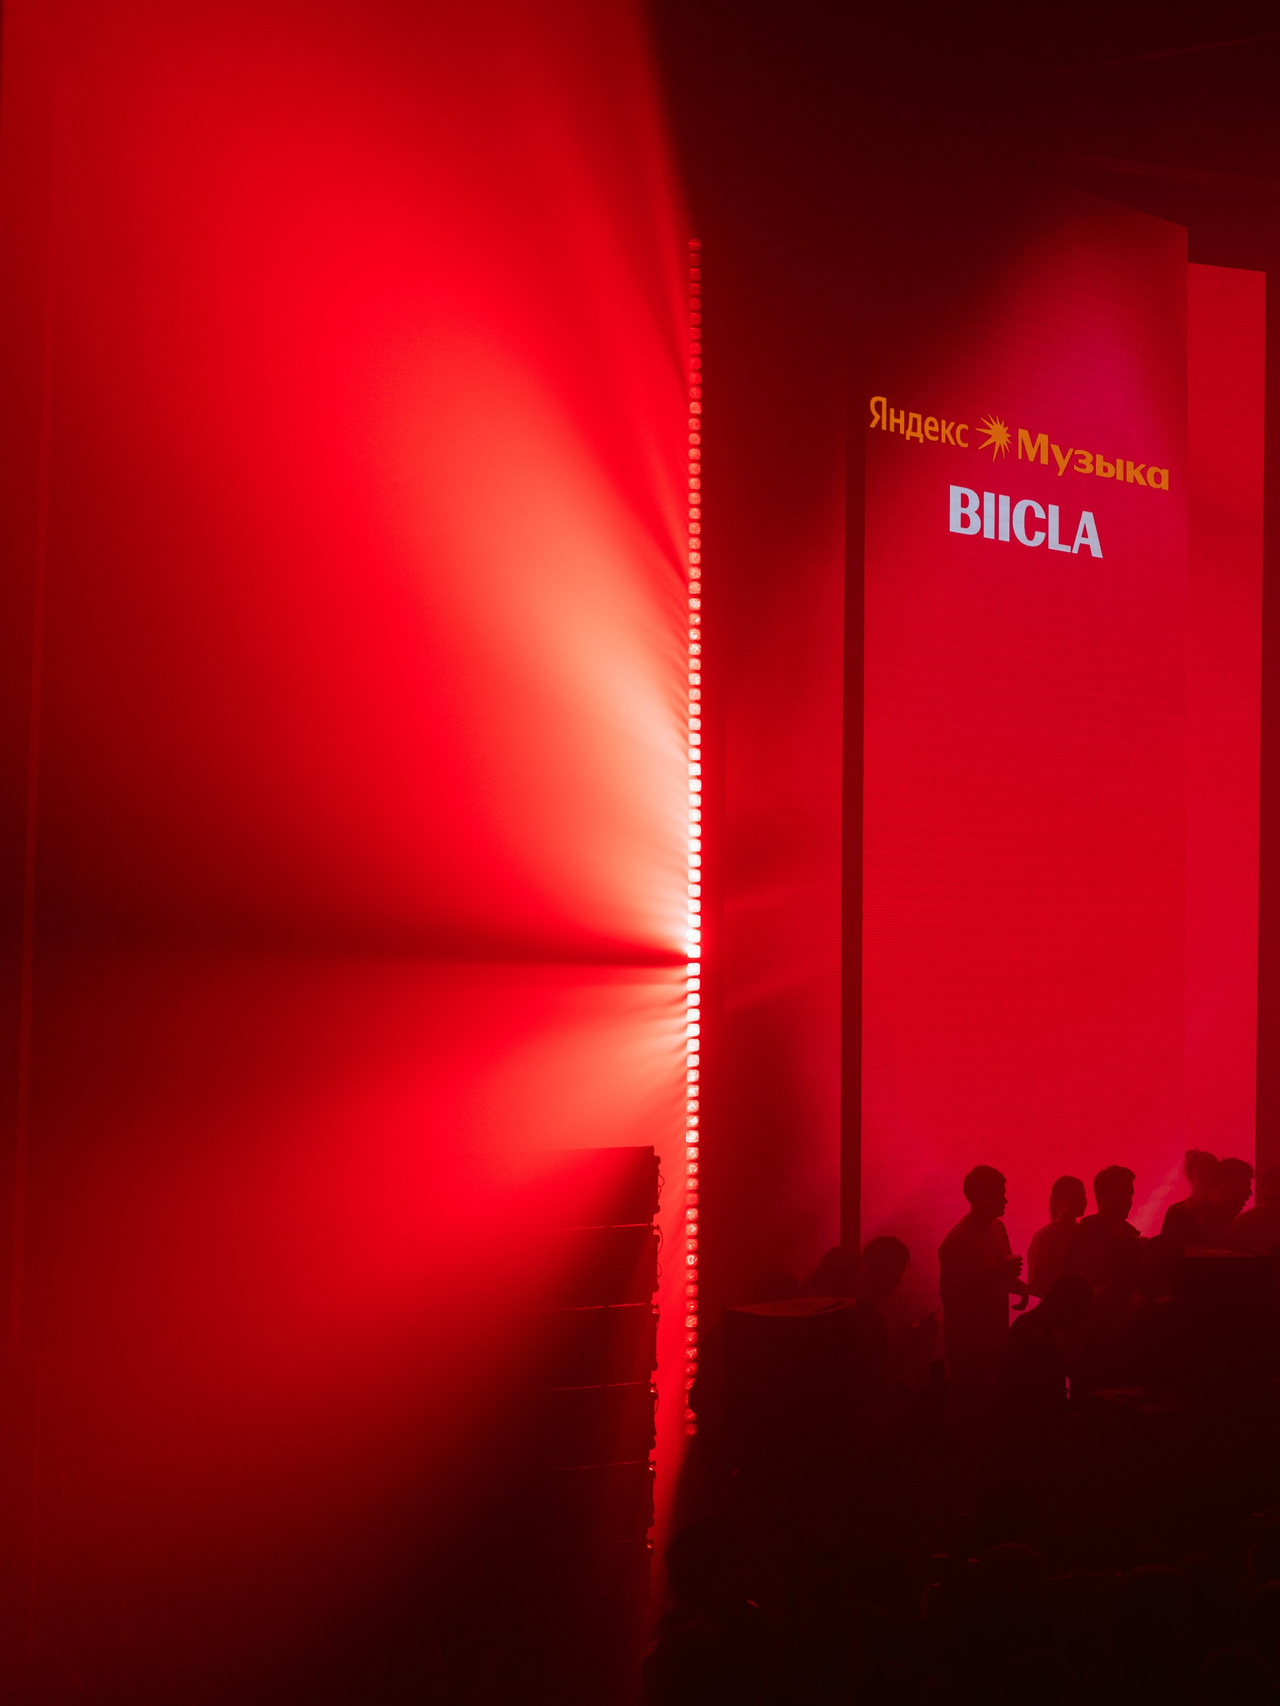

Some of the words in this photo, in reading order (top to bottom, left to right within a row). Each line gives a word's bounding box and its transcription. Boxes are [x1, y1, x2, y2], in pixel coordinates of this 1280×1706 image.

[870, 397, 968, 447] Яндекс
[1019, 429, 1168, 490] Музыка
[950, 485, 1103, 558] BIICLA
